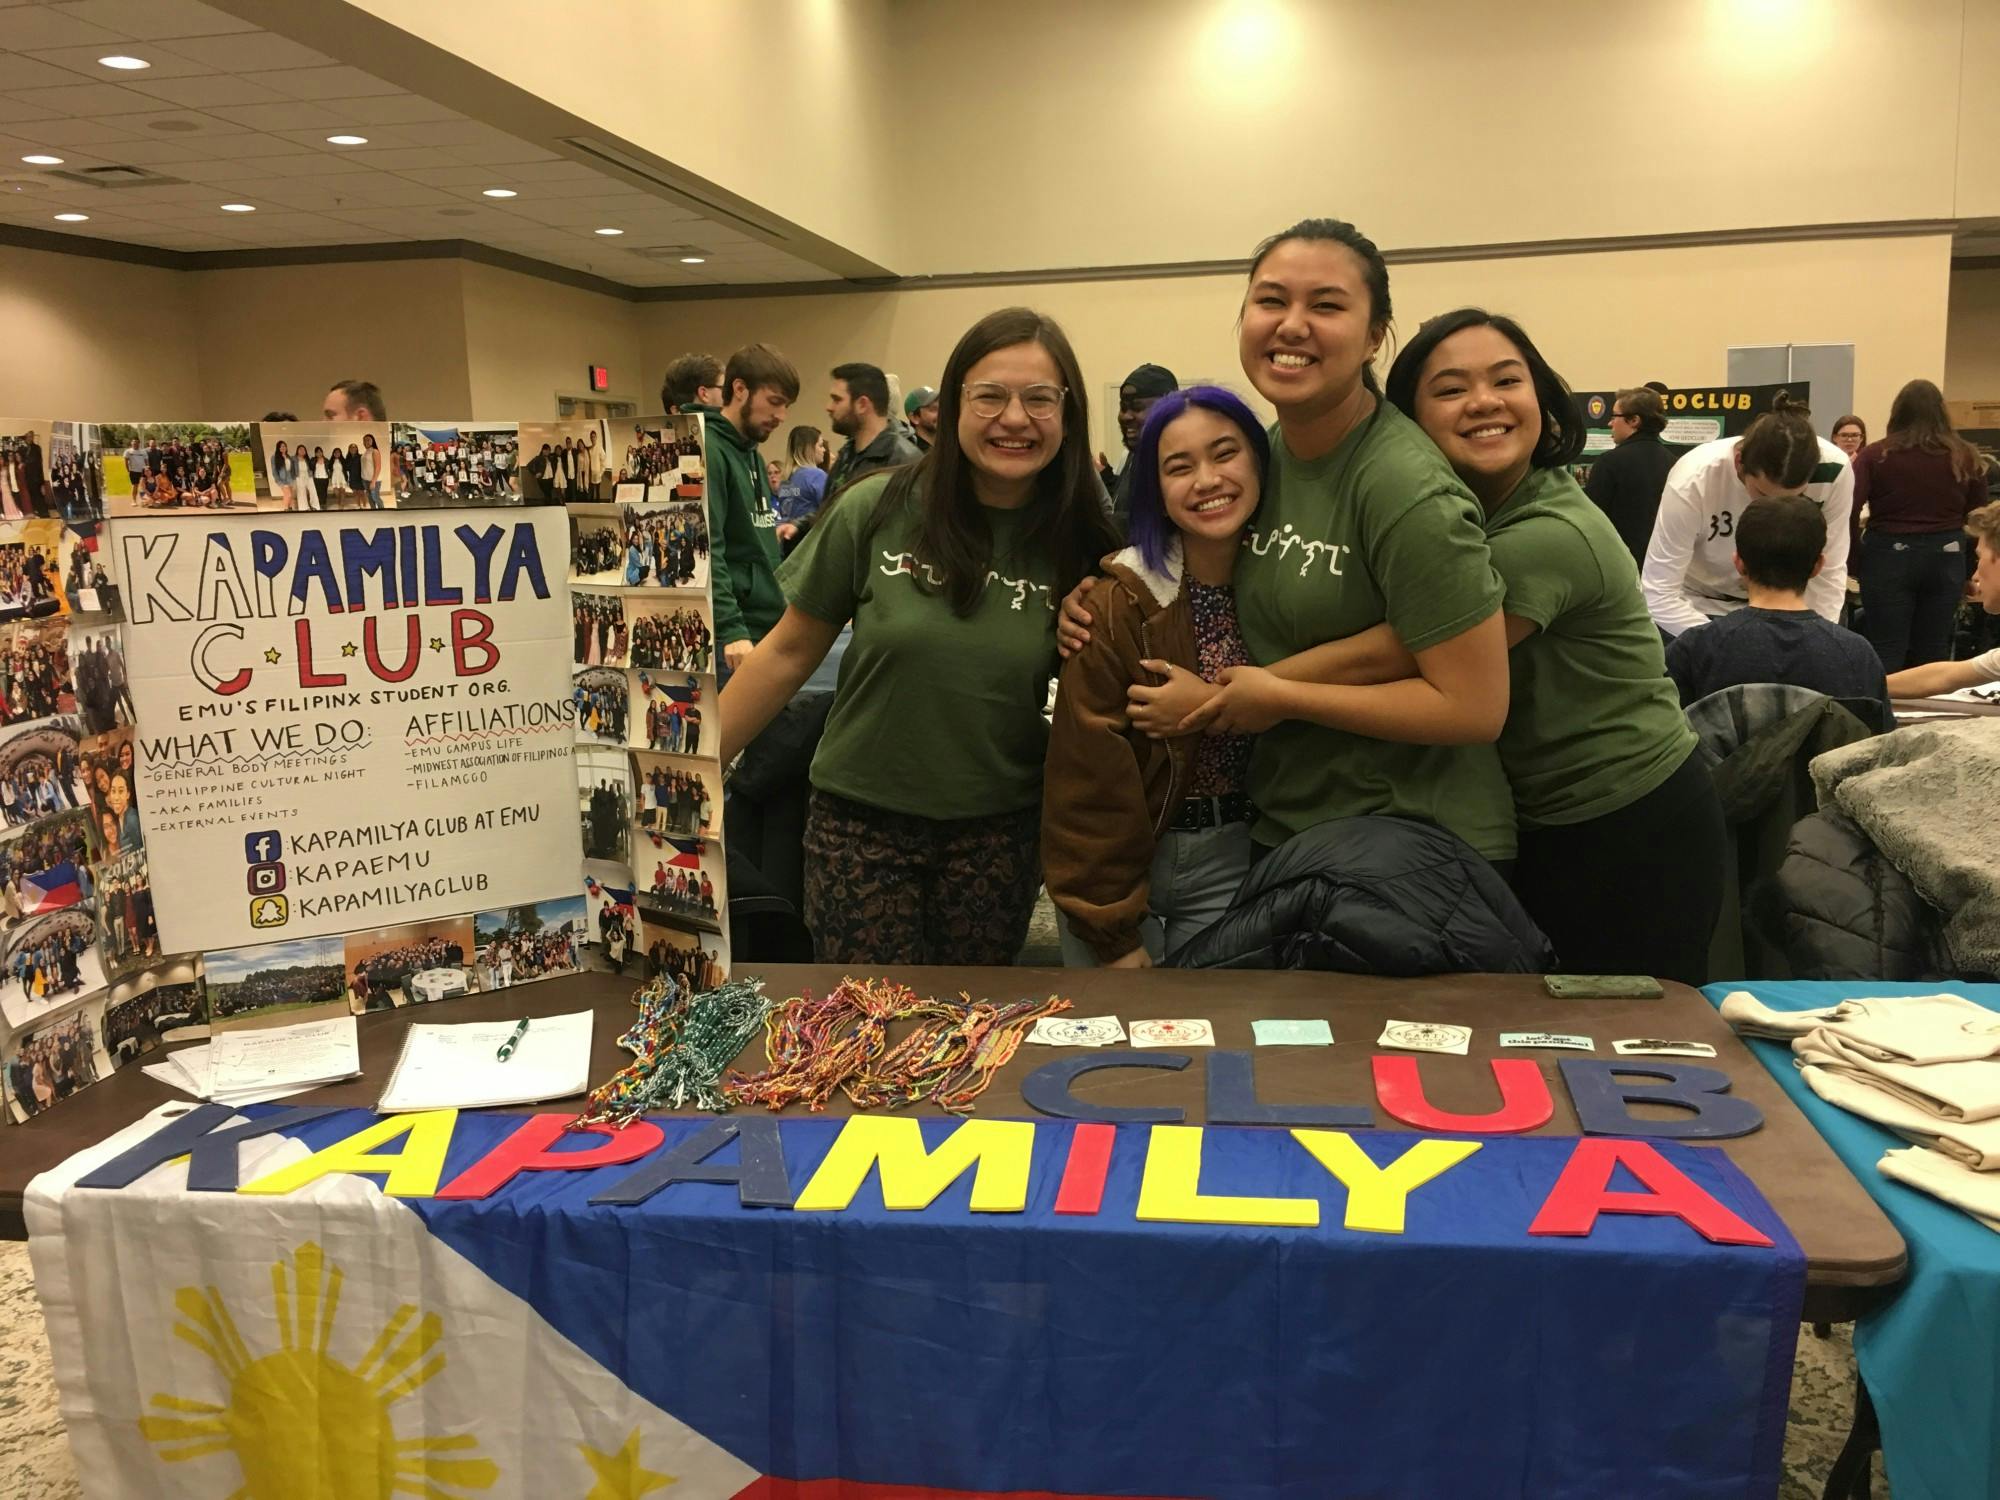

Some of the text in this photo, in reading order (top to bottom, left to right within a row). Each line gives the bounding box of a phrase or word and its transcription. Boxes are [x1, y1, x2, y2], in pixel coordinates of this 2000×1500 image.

[1660, 393, 1751, 410] EOCLUB
[1708, 511, 1733, 541] 33
[123, 522, 551, 624] KAPAMILYA
[178, 700, 258, 721] EMU'S
[266, 692, 361, 714] FILIPINX
[371, 684, 458, 704] STUDENT
[405, 698, 577, 737] AFFILIATIONS
[139, 728, 238, 763] WHAT
[251, 723, 304, 752] WE
[446, 739, 492, 754] CAMPUS
[497, 737, 523, 750] LIFE
[511, 752, 522, 763] OF
[523, 748, 568, 762] FILIPINOS
[232, 761, 269, 774] BODY
[274, 754, 348, 770] MEETINGS
[250, 776, 319, 790] CULTURAL
[324, 768, 366, 781] NIGHT
[198, 796, 263, 812] FAMILIES
[240, 809, 298, 822] EVENTS
[424, 816, 468, 837] CLUB
[474, 810, 495, 830] AT
[500, 803, 540, 827] EMU
[1020, 1050, 1765, 1140] CLUB
[74, 1102, 1775, 1248] KAPAMILYA
